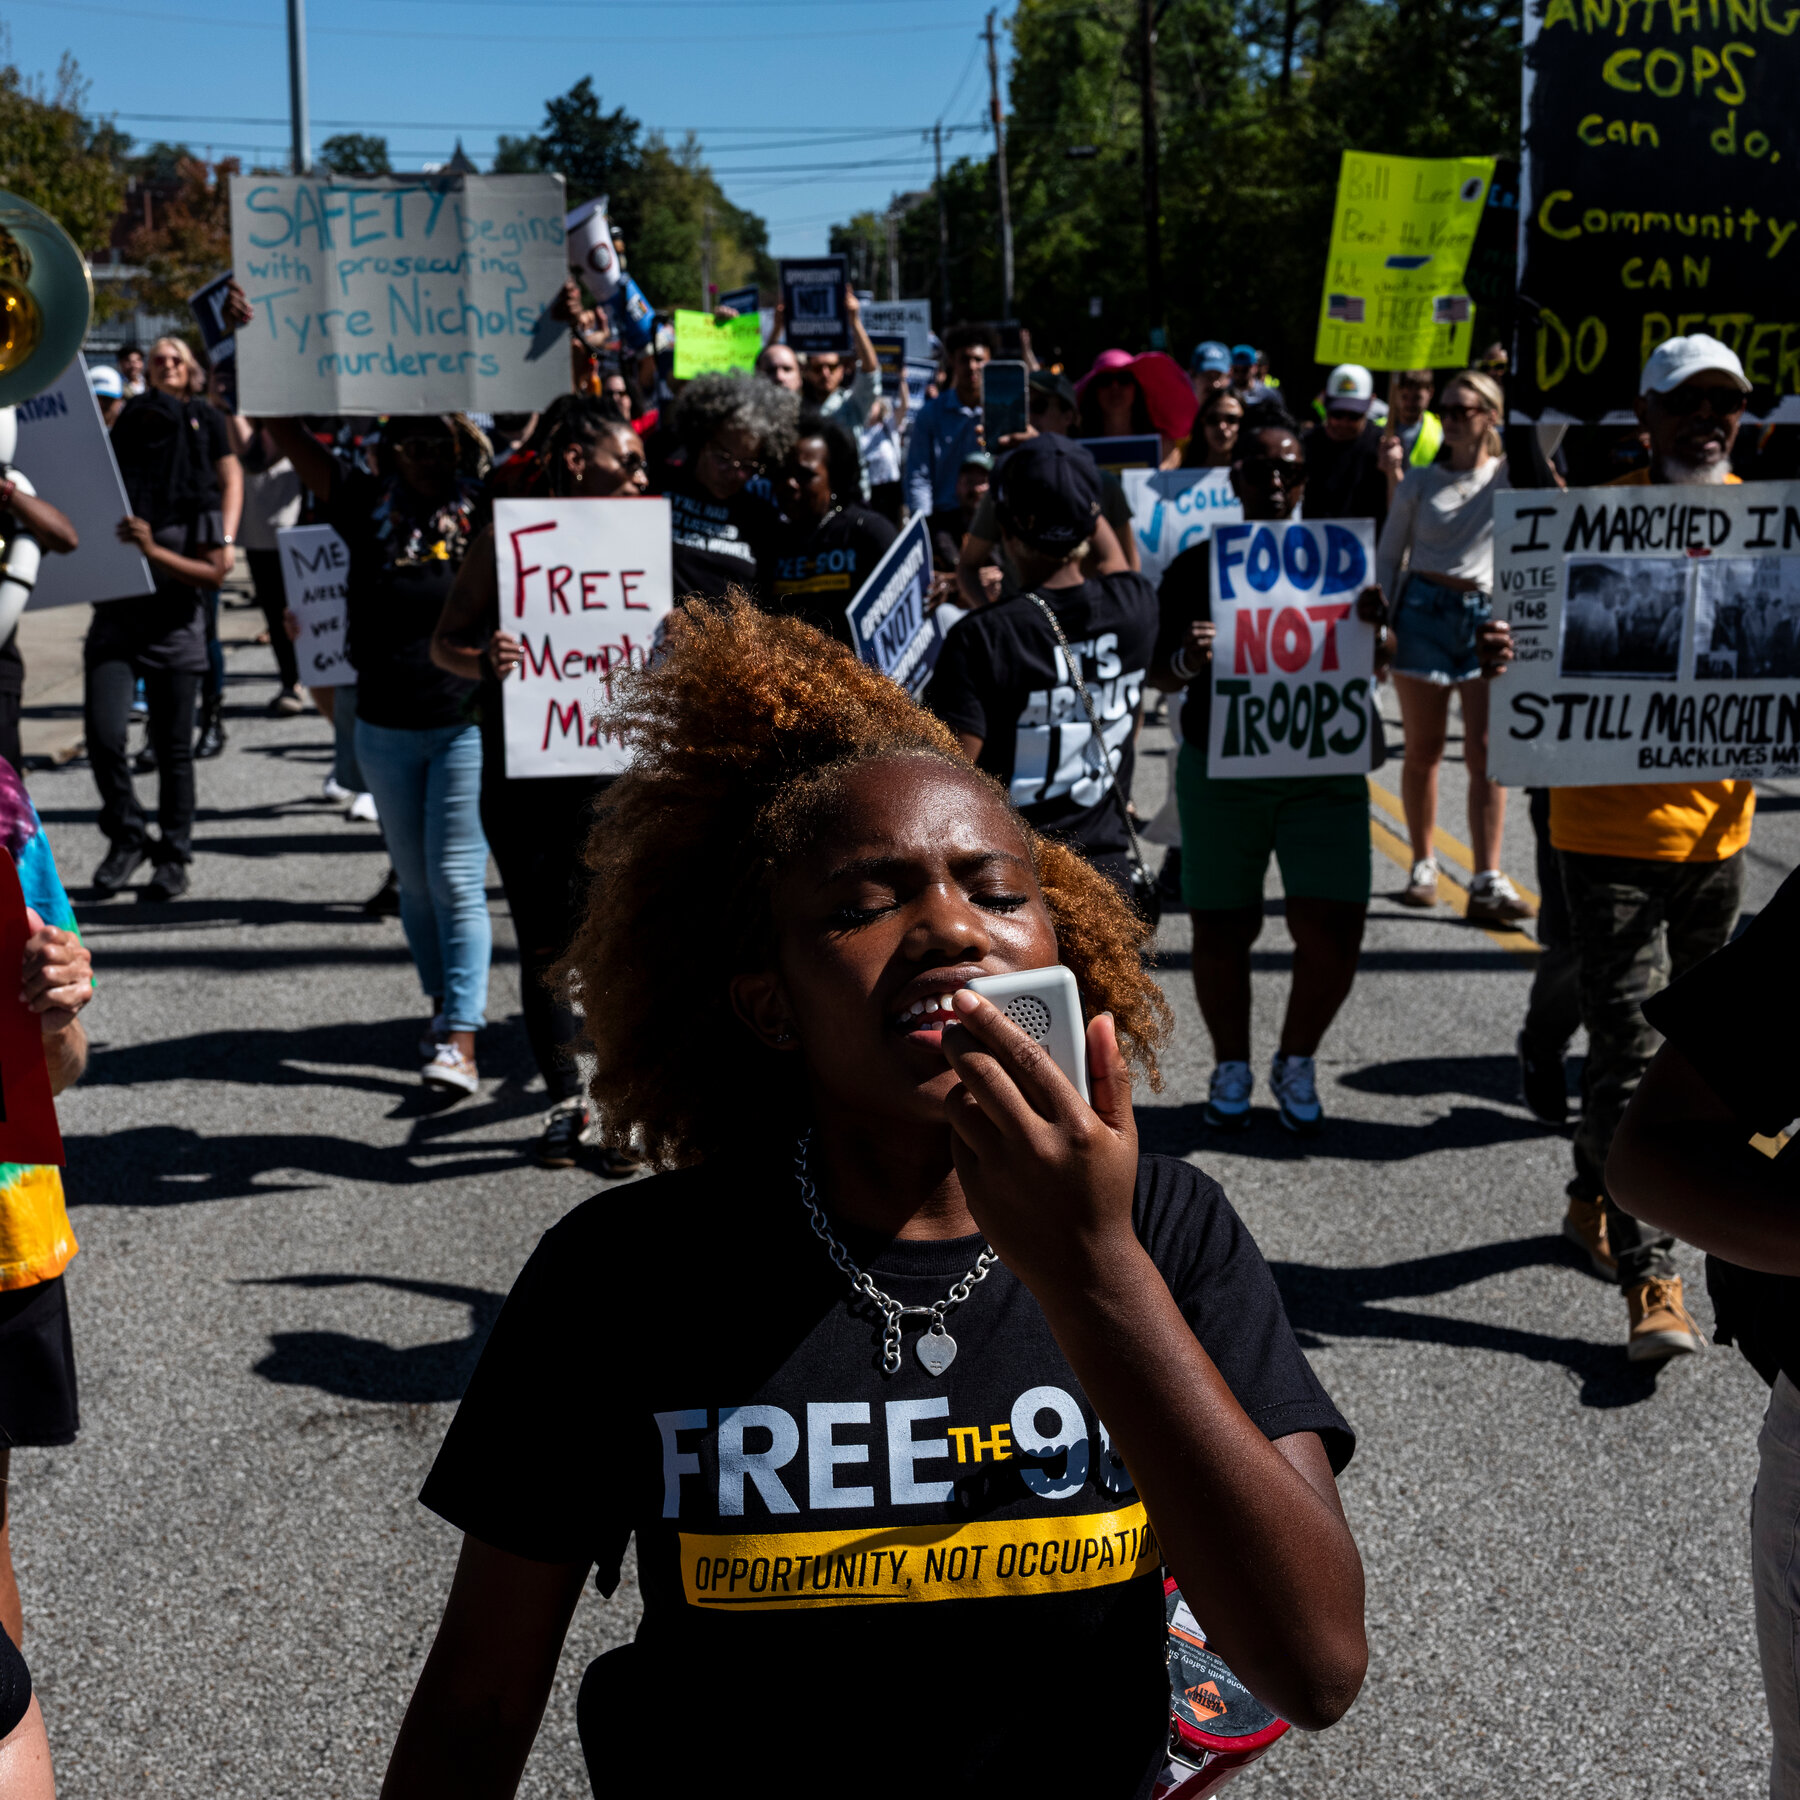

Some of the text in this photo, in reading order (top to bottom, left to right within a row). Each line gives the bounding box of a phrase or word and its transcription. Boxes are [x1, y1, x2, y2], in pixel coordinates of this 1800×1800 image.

[1543, 0, 1800, 36] ANYTHING
[1603, 42, 1756, 105] COPS
[1577, 110, 1781, 164] can do,
[246, 178, 564, 256] SAFETY begins
[1539, 190, 1797, 259] Community
[248, 248, 528, 295] with prosecuting
[1621, 255, 1710, 289] CAN
[251, 287, 374, 353] Tyre
[318, 342, 499, 377] murderers
[1537, 308, 1608, 391] DO
[1510, 507, 1557, 554] I
[1563, 503, 1731, 554] MARCHED
[510, 521, 651, 618] FREE
[1215, 524, 1367, 600] FOOD
[1500, 566, 1557, 591] VOTE
[1053, 632, 1122, 686] IT'S
[1233, 603, 1351, 675] NOT
[520, 633, 653, 701] Memph
[1215, 678, 1369, 760] TROOPS
[1509, 692, 1632, 741] STILL
[1639, 747, 1709, 769] BLACK
[1712, 745, 1767, 766] LIVES
[653, 1396, 954, 1519] FREE
[948, 1423, 1013, 1463] THE
[695, 1548, 912, 1593] OPPORTUNITY,
[925, 1542, 990, 1583] NOT
[1180, 1654, 1208, 1674] Safety
[1206, 1668, 1226, 1683] with
[1227, 1678, 1251, 1695] hone
